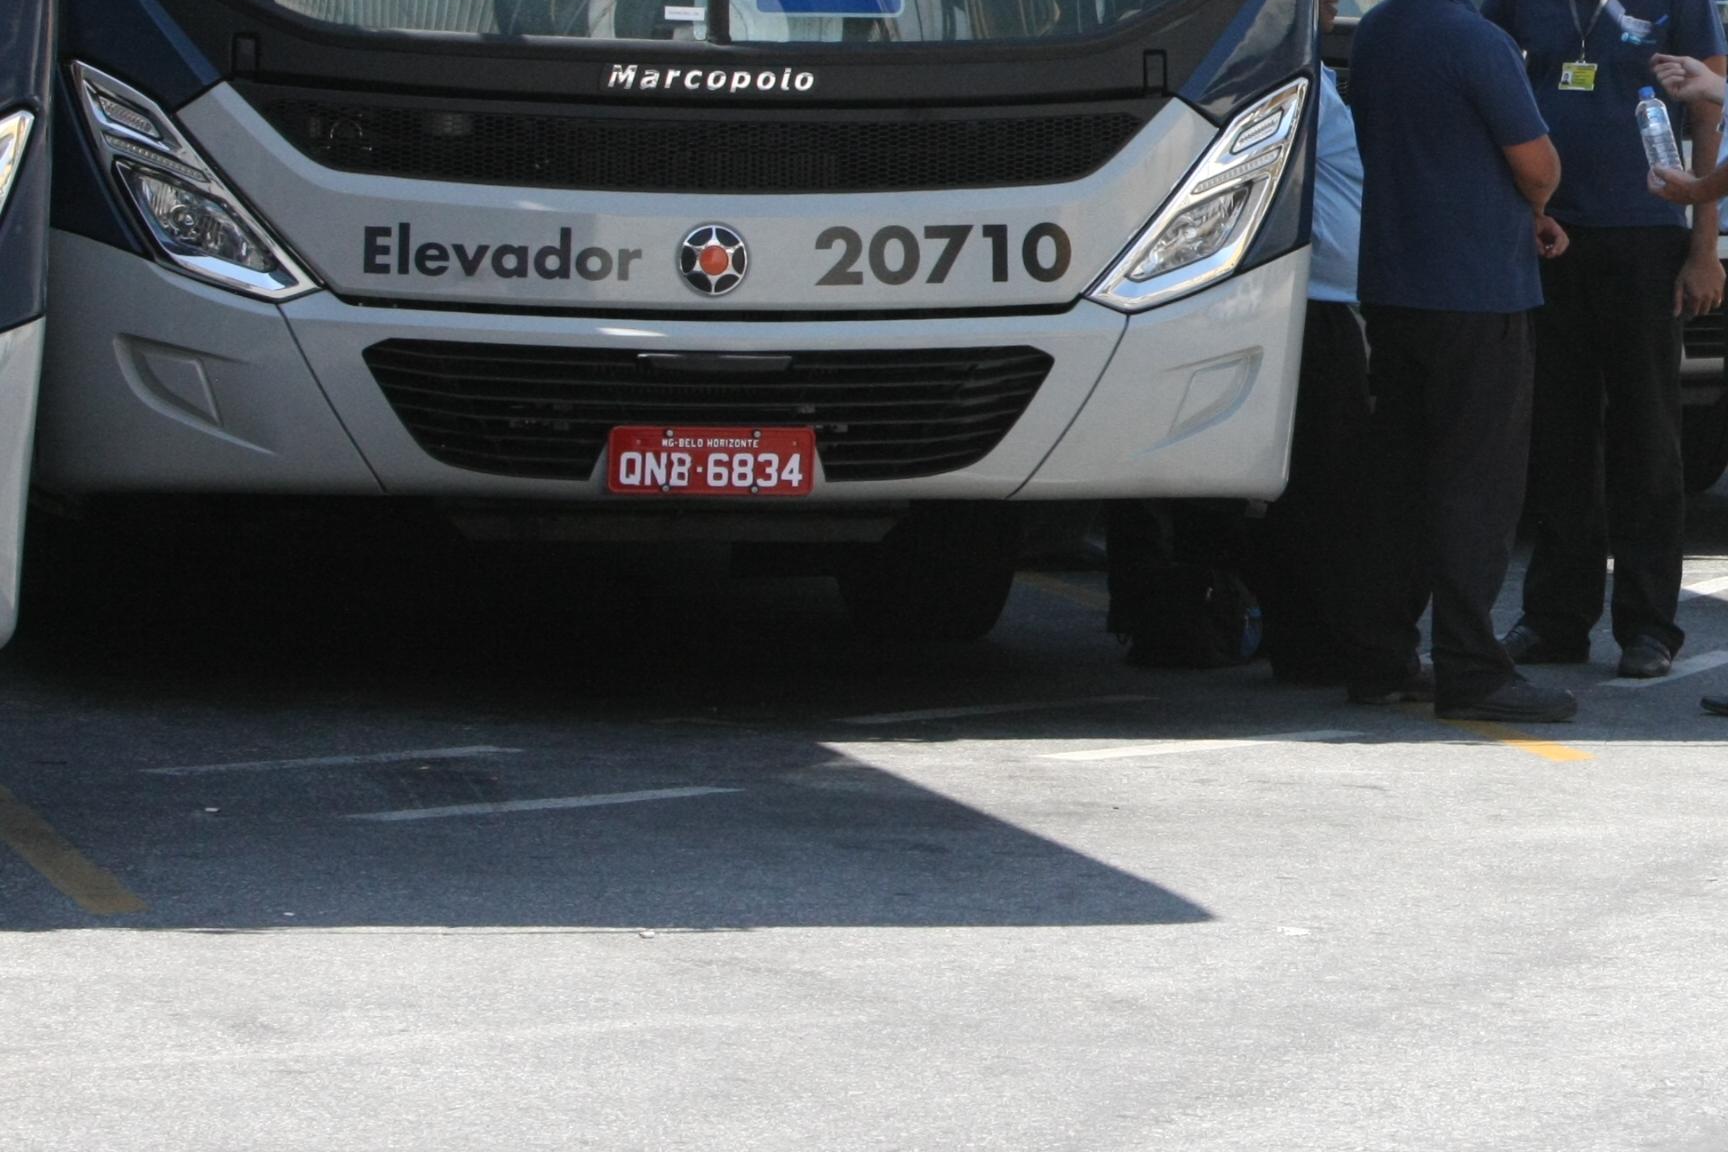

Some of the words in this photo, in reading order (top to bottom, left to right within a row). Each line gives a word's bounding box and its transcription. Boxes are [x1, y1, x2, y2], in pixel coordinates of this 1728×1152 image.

[607, 64, 815, 93] Marcopolo
[363, 223, 642, 282] Elevador
[815, 222, 1072, 286] 20710
[707, 438, 759, 448] HORIZONTE
